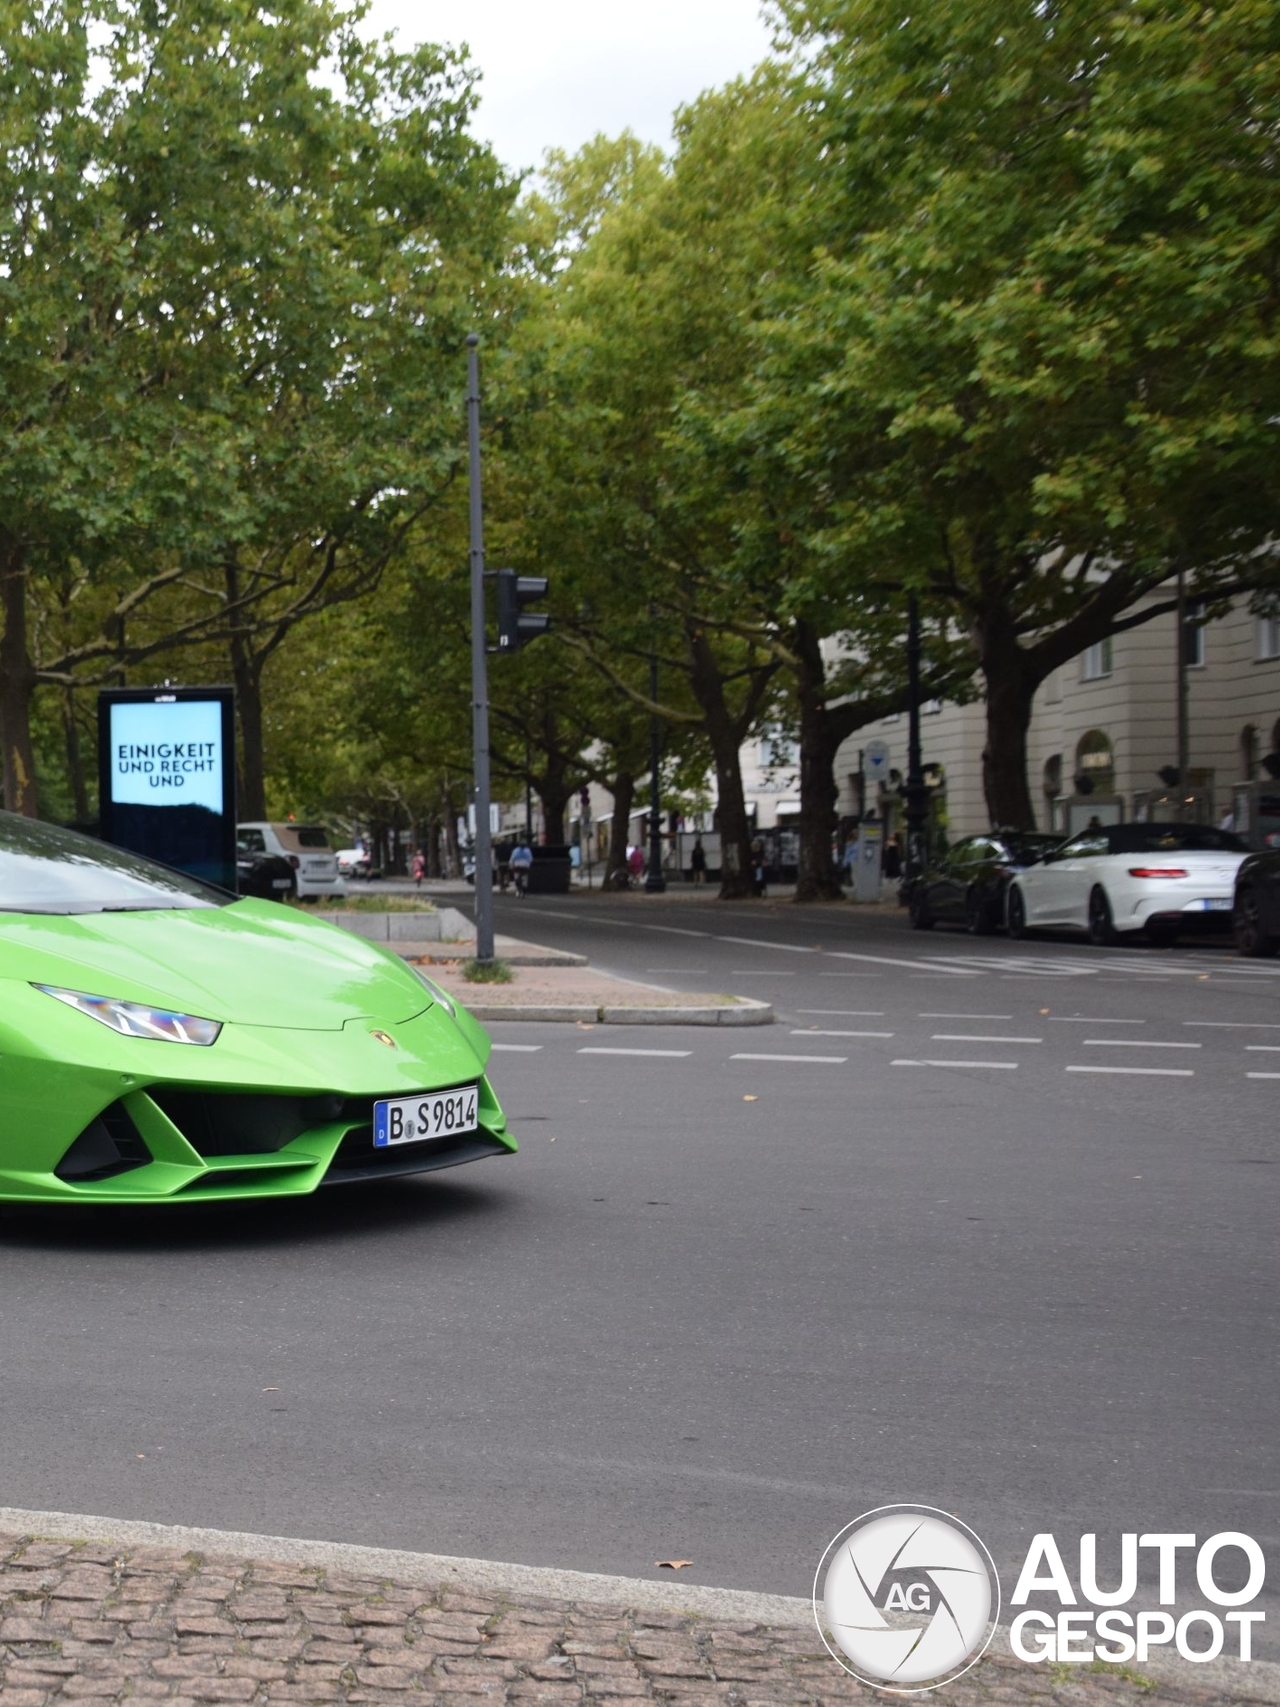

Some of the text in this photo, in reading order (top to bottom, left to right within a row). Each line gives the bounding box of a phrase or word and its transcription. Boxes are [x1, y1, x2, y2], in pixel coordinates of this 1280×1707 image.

[118, 742, 216, 759] EINIGKEIT
[118, 759, 215, 774] UND RECHT
[149, 774, 185, 788] UND
[378, 1129, 385, 1139] D
[390, 1107, 404, 1140] B
